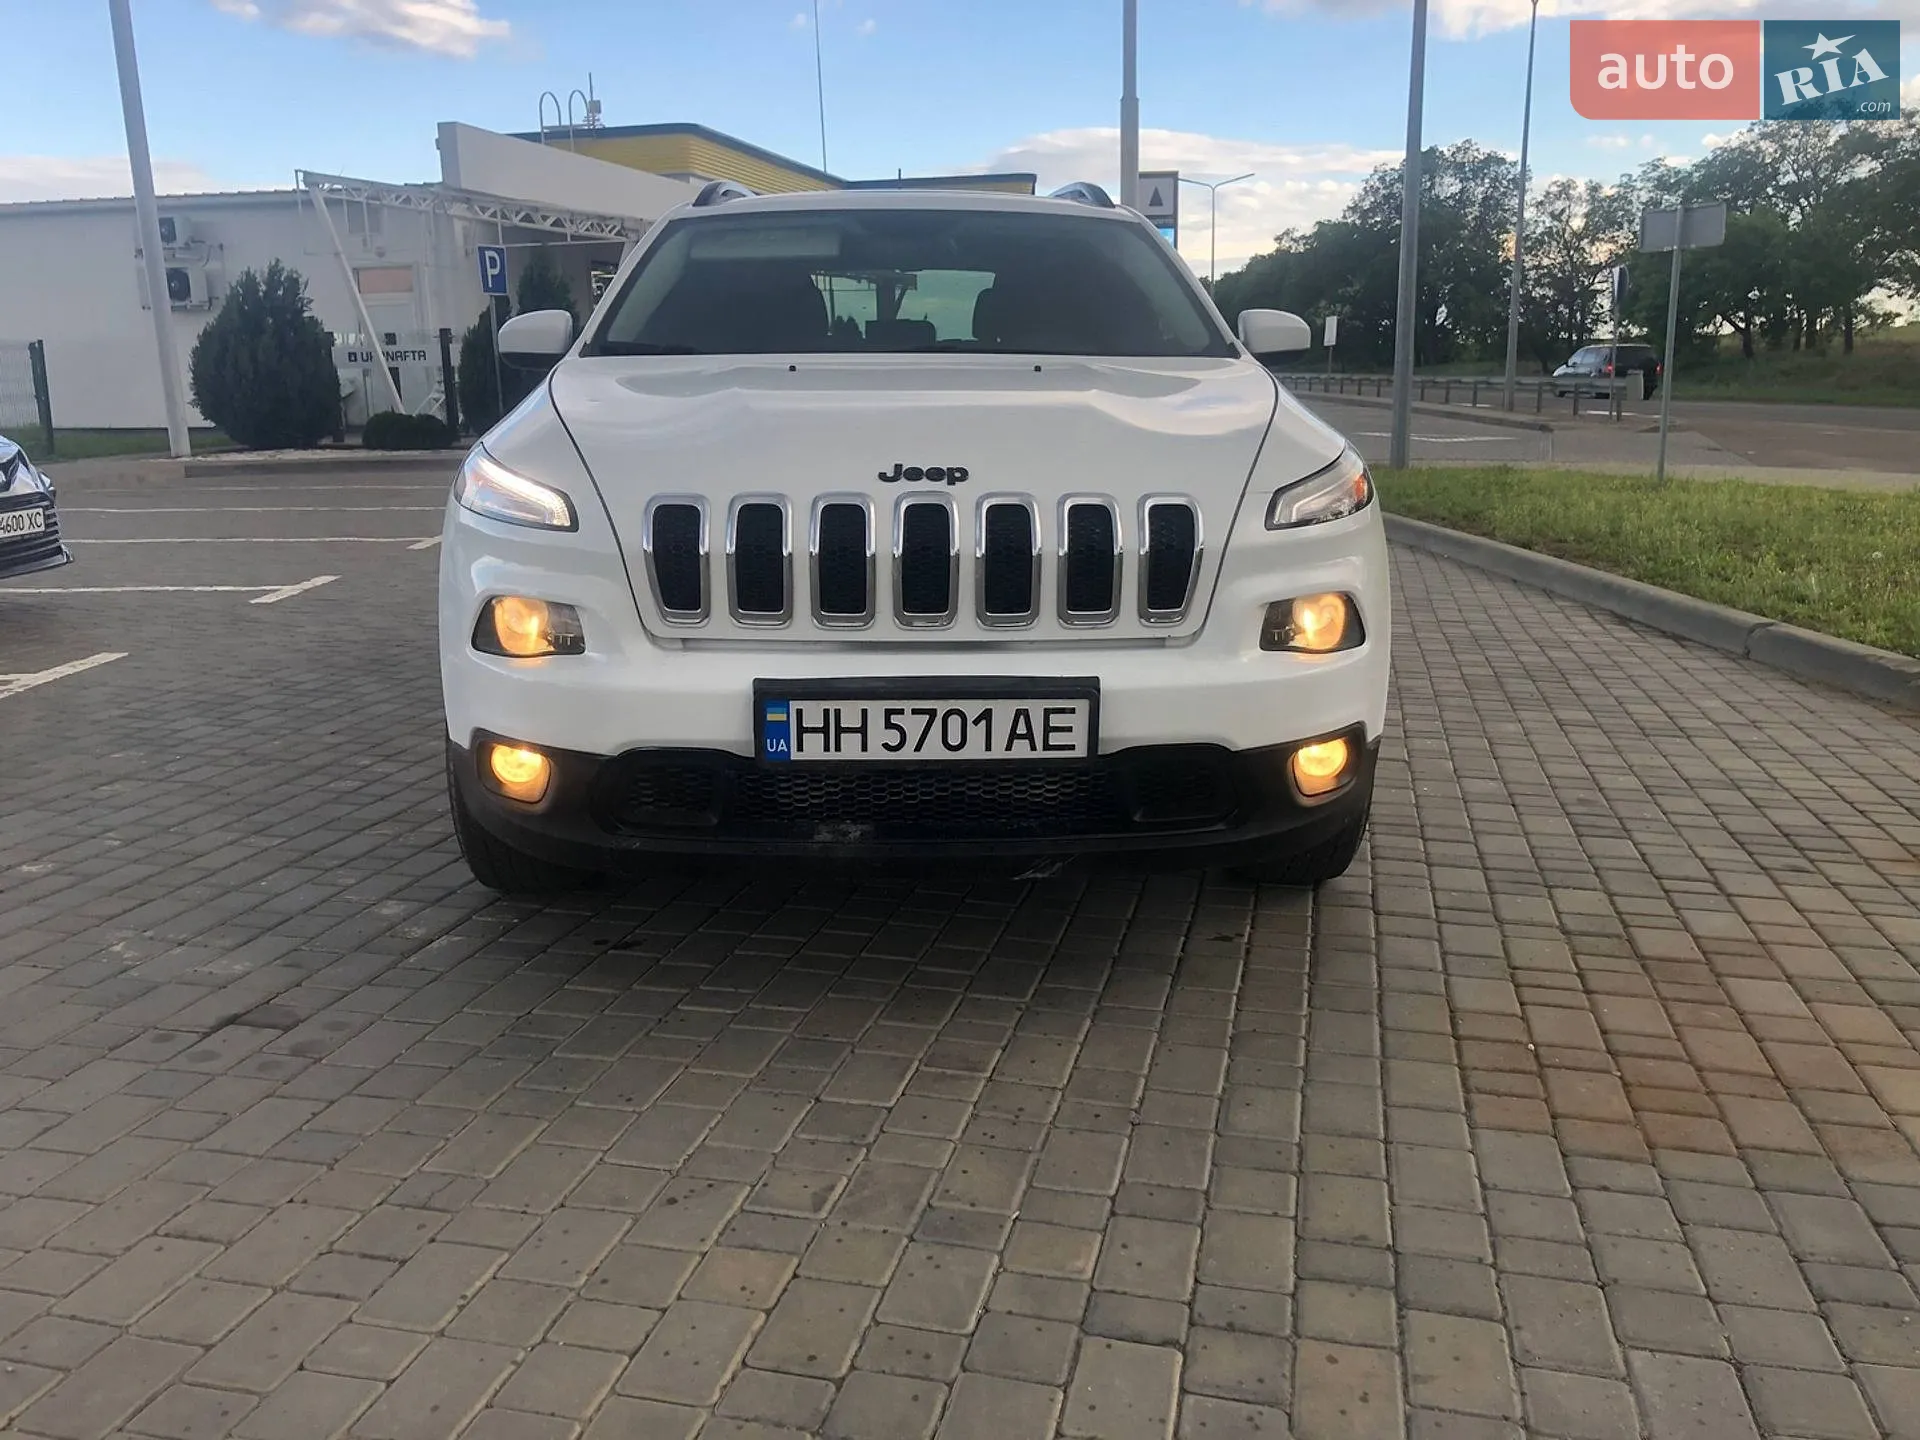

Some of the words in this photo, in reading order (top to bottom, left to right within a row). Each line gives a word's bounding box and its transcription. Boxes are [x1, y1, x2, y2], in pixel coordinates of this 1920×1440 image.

[485, 250, 500, 288] P
[878, 463, 969, 486] Jeep
[26, 511, 43, 530] XC
[795, 708, 868, 753] HH
[881, 708, 993, 752] 5701
[1004, 707, 1076, 752] AE
[766, 738, 788, 752] UA
